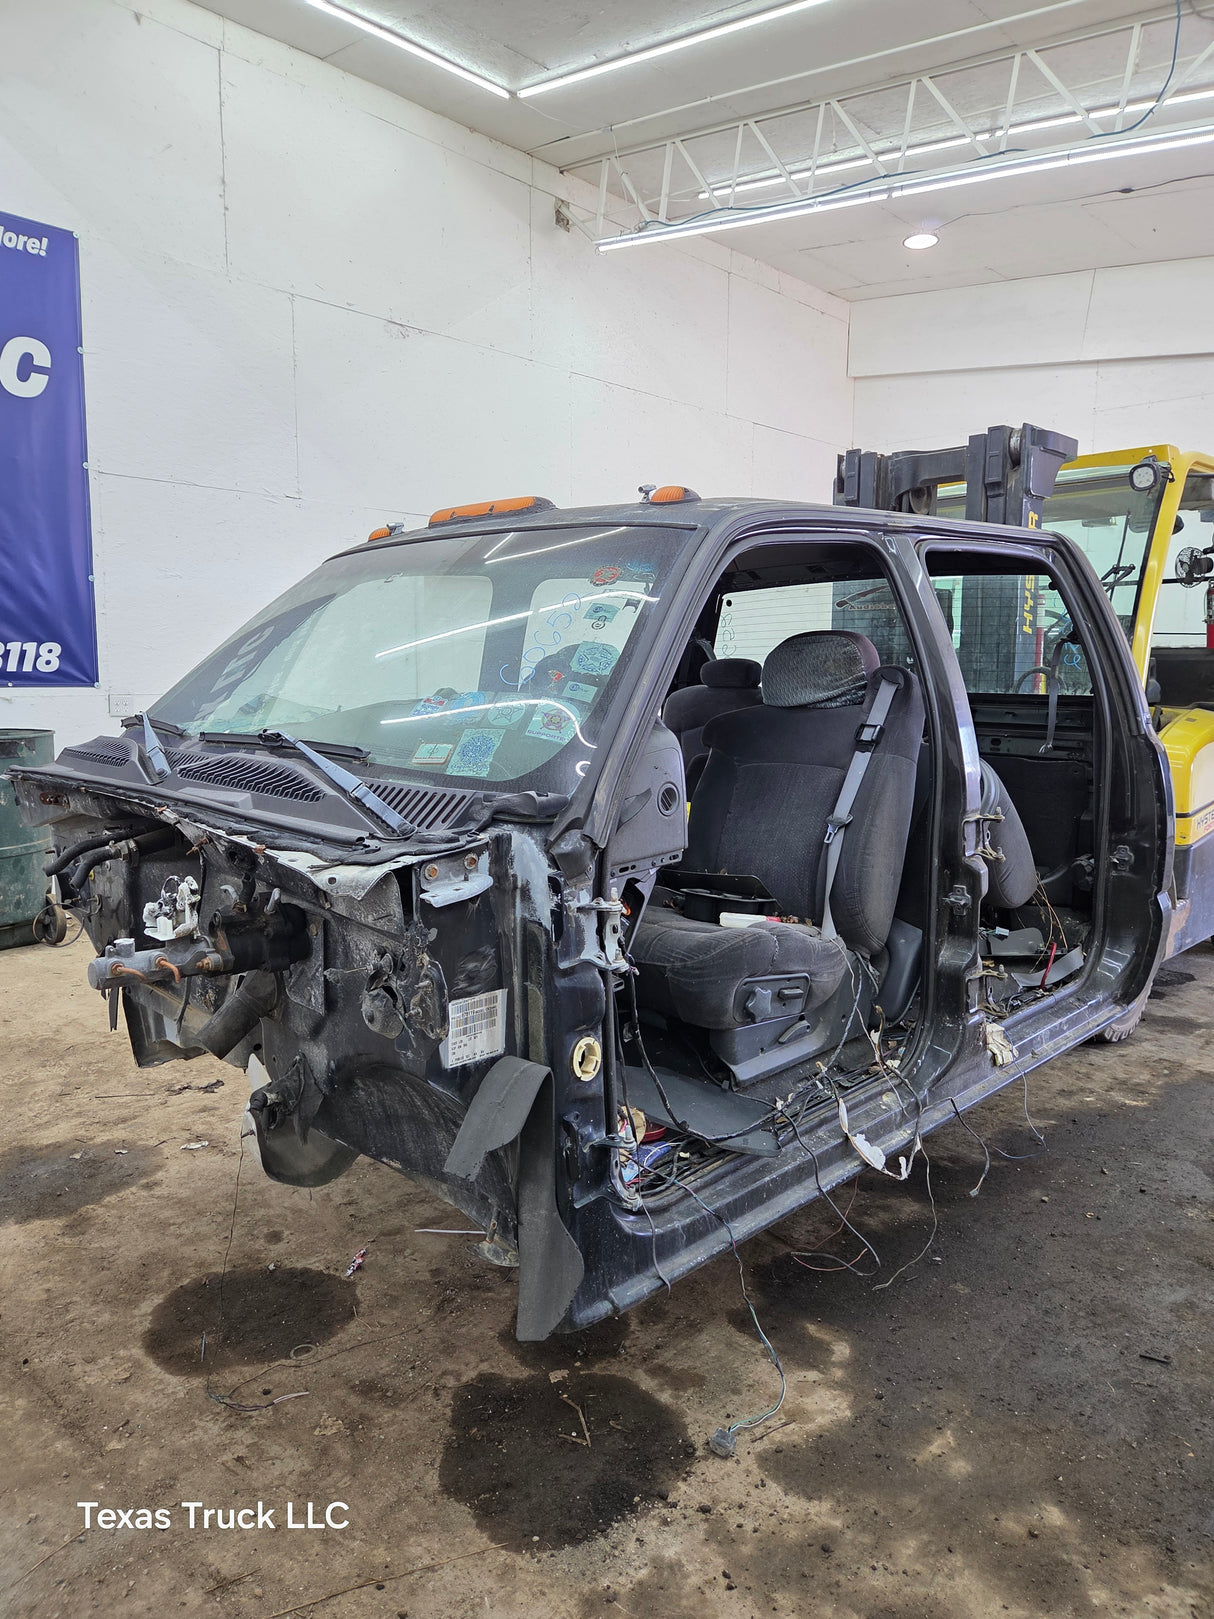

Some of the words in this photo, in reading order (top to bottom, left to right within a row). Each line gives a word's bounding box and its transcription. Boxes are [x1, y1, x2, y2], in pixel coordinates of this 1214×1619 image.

[0, 225, 48, 257] ore!
[0, 336, 51, 398] C
[0, 641, 62, 673] 118
